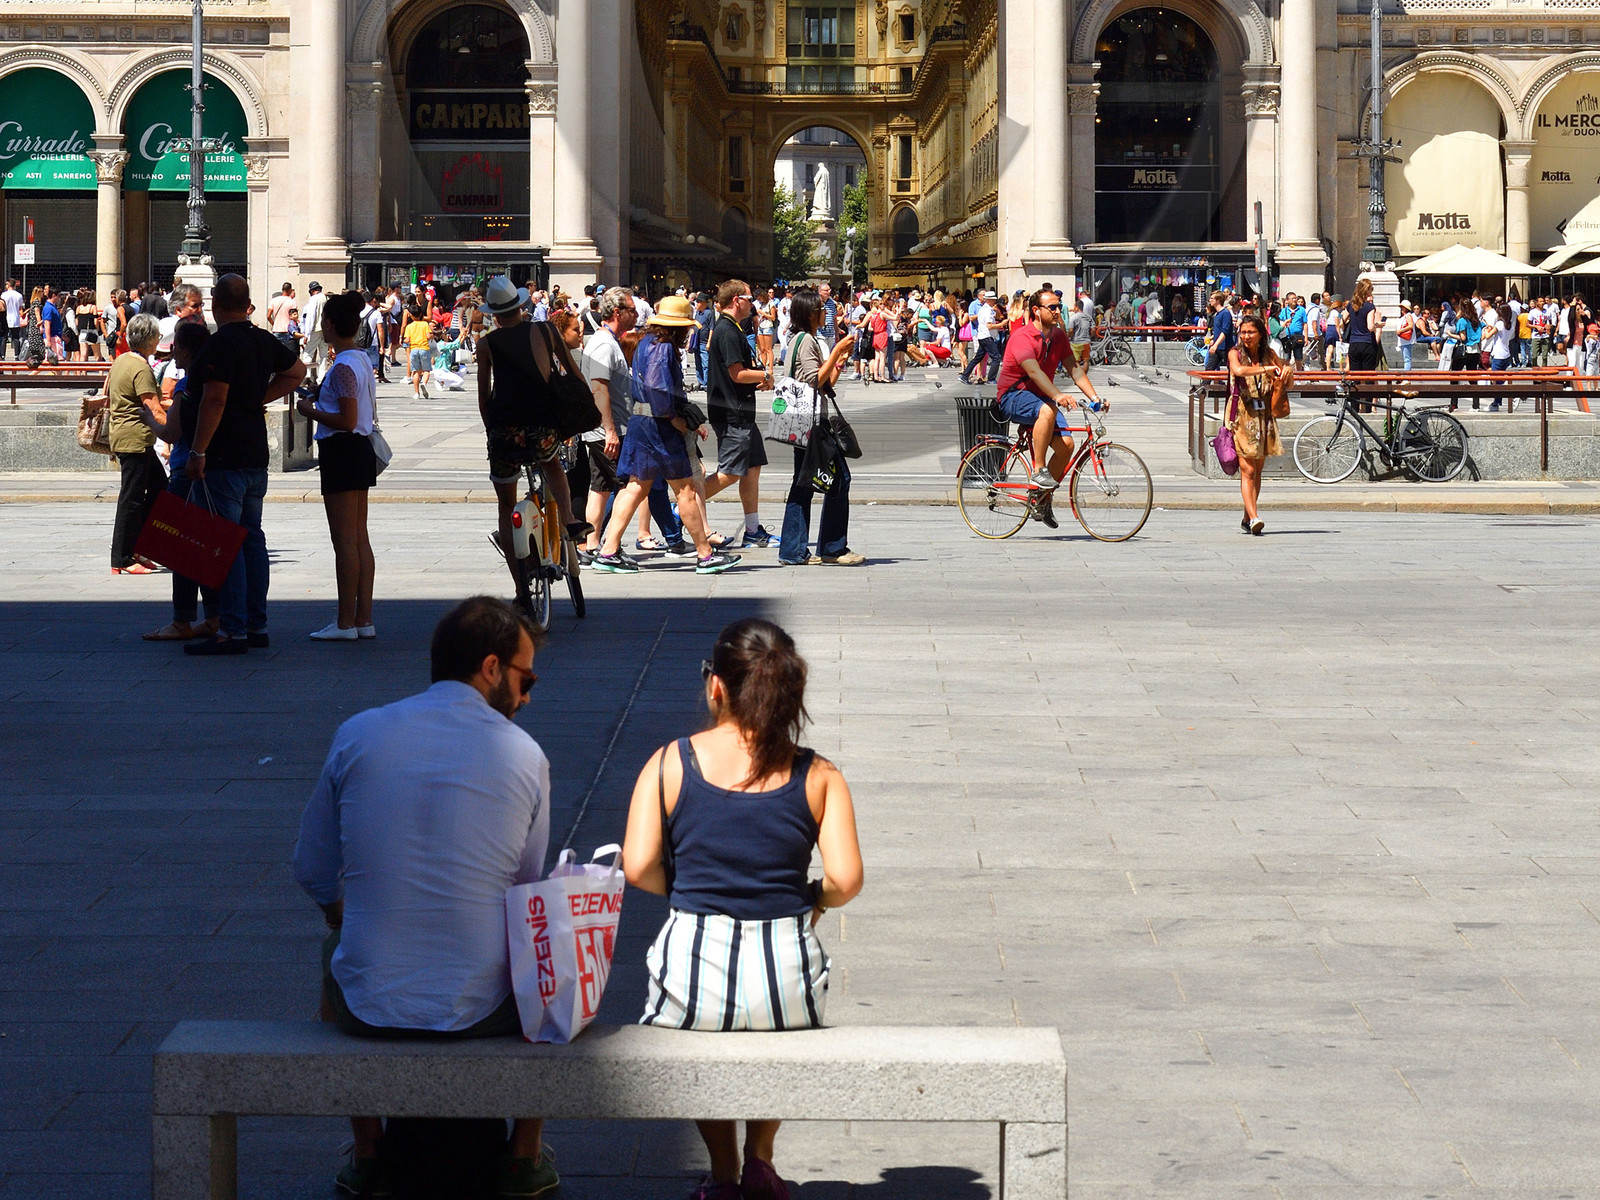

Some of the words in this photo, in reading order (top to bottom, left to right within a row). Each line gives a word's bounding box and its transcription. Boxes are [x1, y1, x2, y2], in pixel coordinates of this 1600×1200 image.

[415, 103, 530, 129] CAMPARI
[1537, 114, 1551, 127] IL
[30, 153, 85, 161] GIOIELLERIE
[180, 155, 235, 163] GILLERIE
[1132, 169, 1178, 184] Motta
[1541, 171, 1571, 181] Motta
[447, 195, 499, 206] CAMPARI
[1417, 212, 1471, 230] Motta
